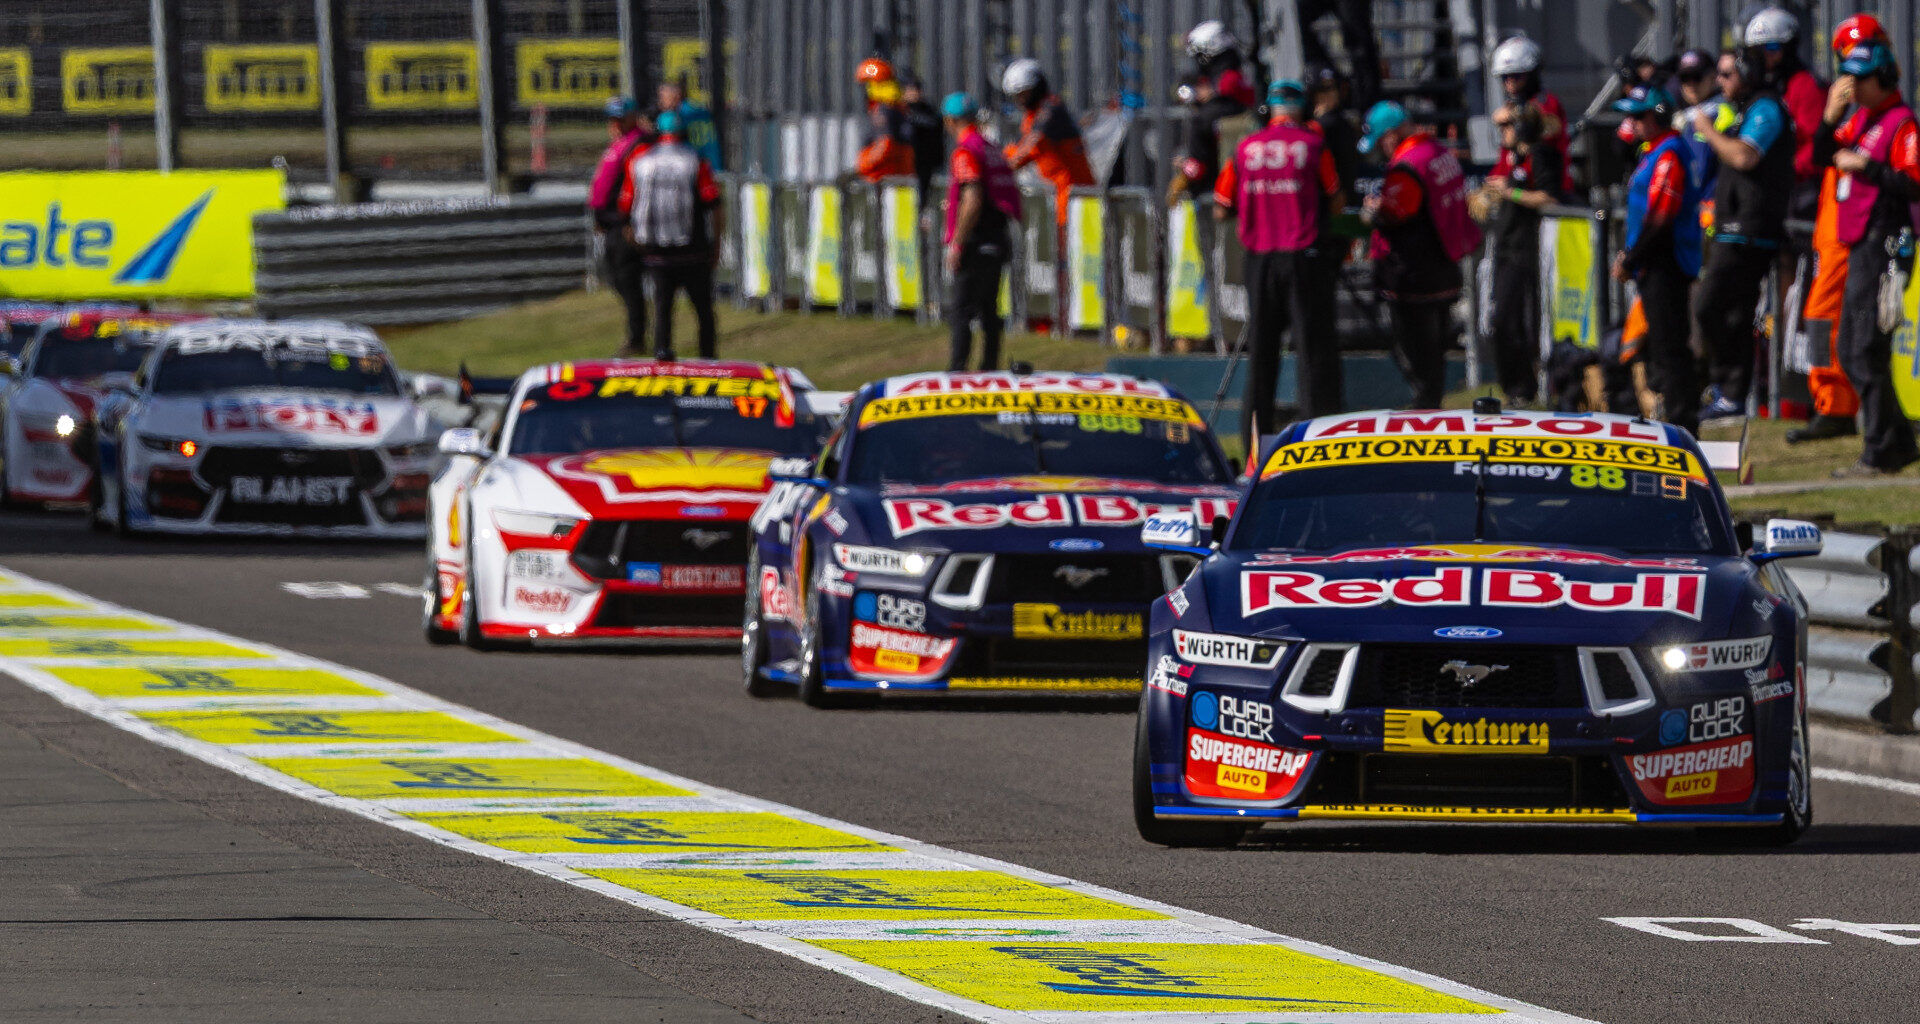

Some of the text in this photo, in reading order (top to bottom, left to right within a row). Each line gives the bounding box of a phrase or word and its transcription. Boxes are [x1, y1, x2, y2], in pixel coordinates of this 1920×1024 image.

[1244, 140, 1307, 170] 331
[873, 392, 1185, 417] NATIONAL STORAGE
[1078, 412, 1142, 434] 888
[1314, 416, 1659, 441] AMPOL
[1279, 438, 1683, 469] NATIONAL STORAGE
[1454, 461, 1626, 490] Feeney 88
[883, 495, 1072, 537] Red
[1242, 567, 1472, 618] Red
[1482, 568, 1706, 620] Bull
[1187, 637, 1248, 661] WÜRTH
[1712, 642, 1767, 664] WÜRTH
[1220, 694, 1273, 724] QUAD
[1691, 696, 1745, 722] QUAD
[1219, 714, 1275, 743] LOCK
[1384, 709, 1549, 754] Century
[1690, 715, 1744, 742] LOCK
[1190, 734, 1308, 778] SUPERCHEAP
[1633, 740, 1753, 781] SUPERCHEAP
[1222, 770, 1261, 787] AUTO
[1671, 777, 1711, 793] AUTO
